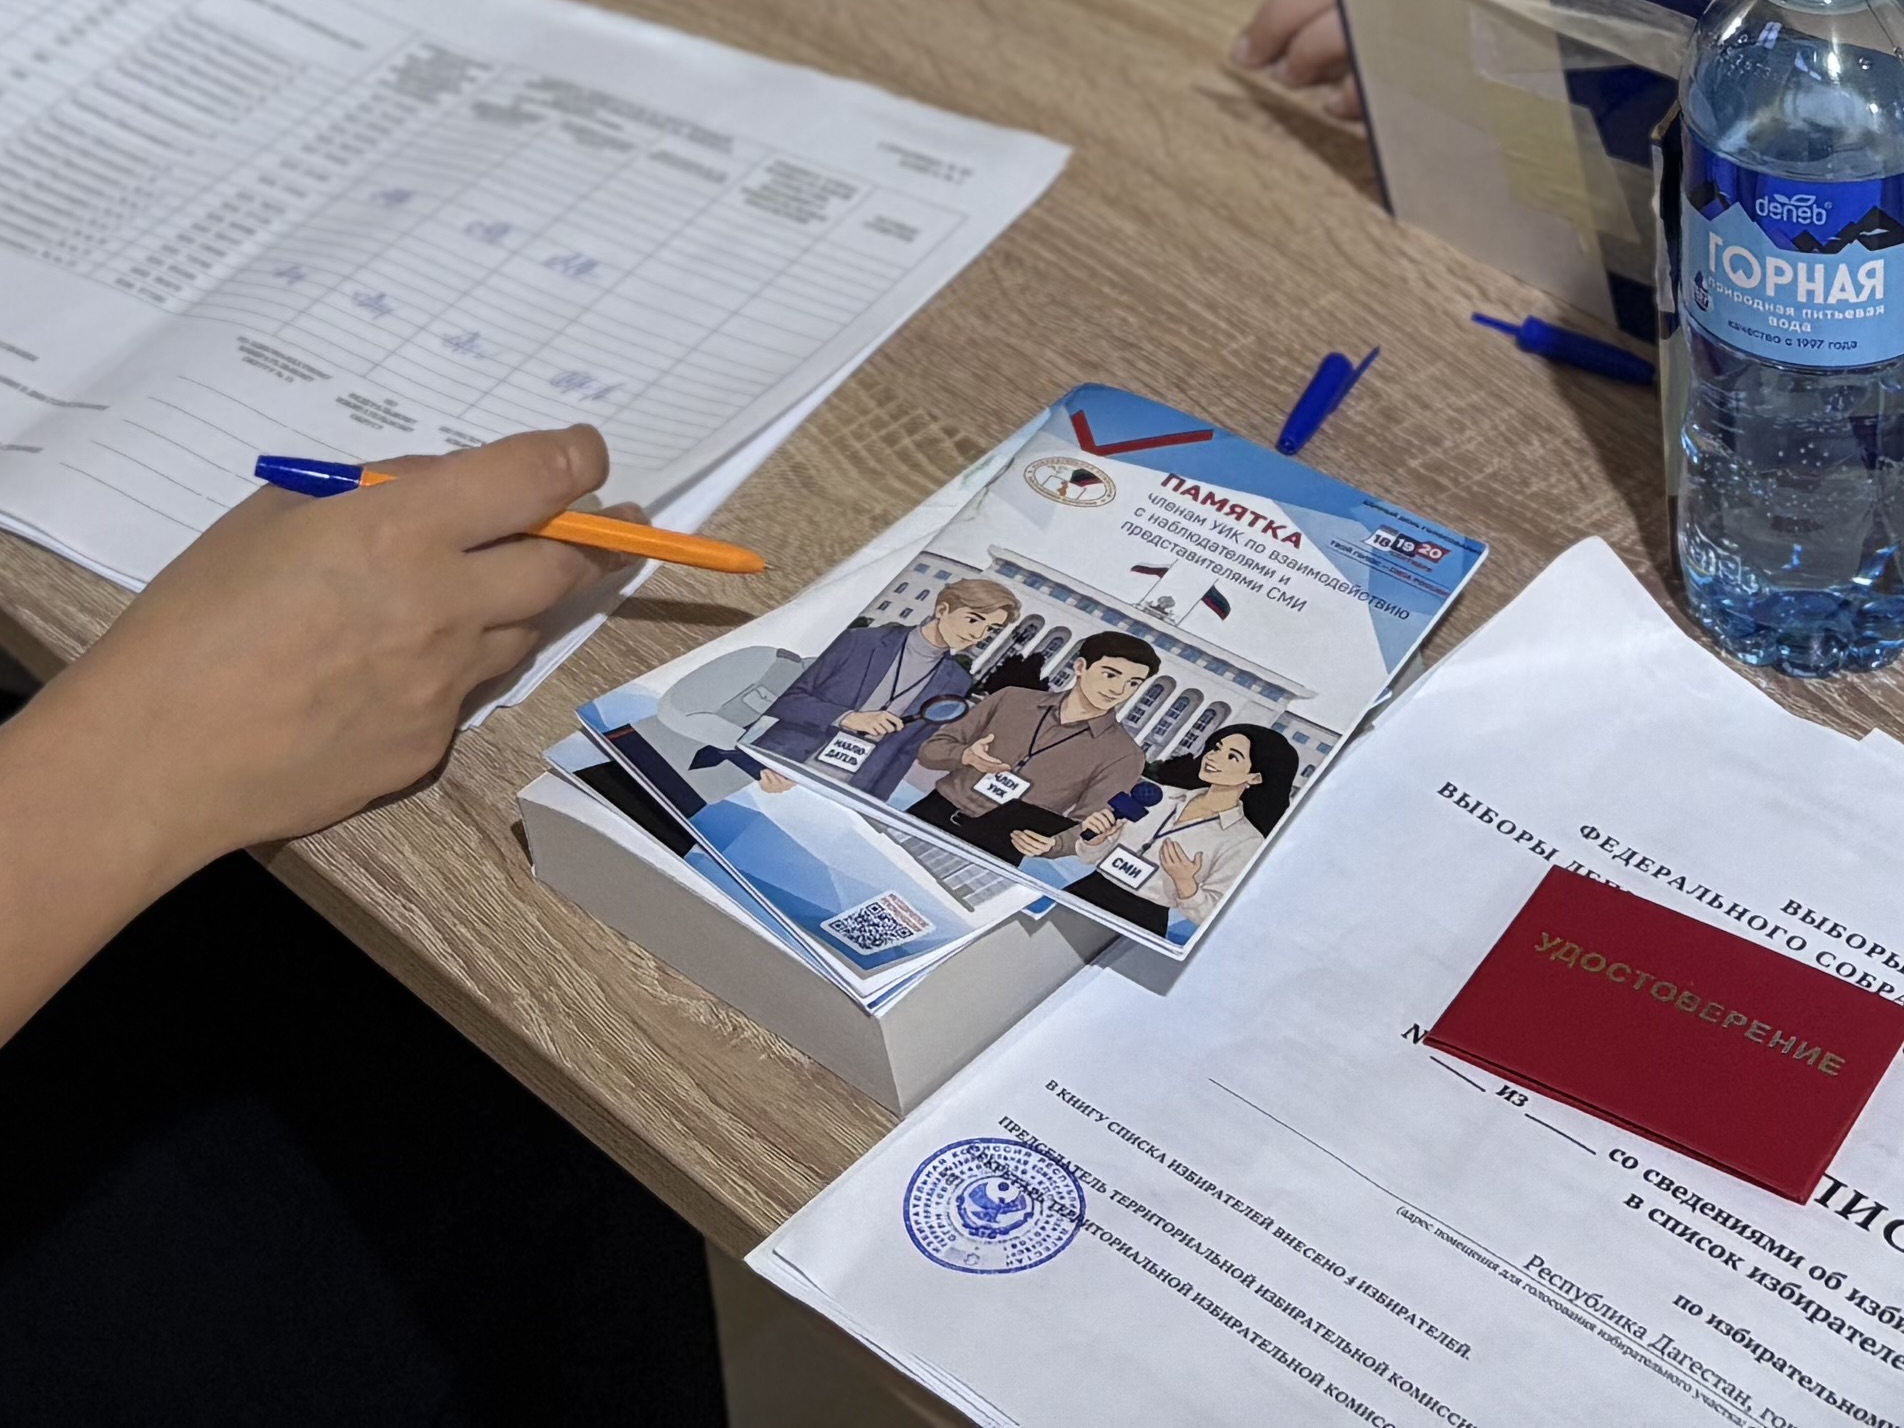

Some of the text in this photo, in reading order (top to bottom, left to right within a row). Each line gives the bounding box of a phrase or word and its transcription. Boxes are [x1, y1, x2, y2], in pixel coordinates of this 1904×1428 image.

[1755, 195, 1827, 225] deneb
[1707, 276, 1795, 317] природная
[1802, 304, 1885, 320] питьевая
[1708, 231, 1885, 305] ГОРНАЯ
[1768, 316, 1812, 333] вода
[1785, 337, 1793, 347] с
[1796, 338, 1825, 350] 1997
[1828, 340, 1858, 351] года
[1134, 506, 1292, 586] с наблюдателями и
[1161, 472, 1304, 548] ПАМЯТКА
[1373, 534, 1390, 547] 18
[1396, 538, 1416, 552] 19
[1418, 544, 1443, 559] 20
[1120, 519, 1309, 613] представителями СМИ
[1147, 493, 1411, 621] членам УИК по взаимодействию
[1437, 781, 1559, 862] ВЫБОРЫ
[1111, 856, 1143, 879] СМИ
[1579, 825, 1807, 951] ФЕДЕРАЛЬНОГО
[1533, 931, 1846, 1078] УДОСТОВЕРЕНИЕ
[909, 1156, 950, 1253] ИЗБИРАТЕЛЬНАЯ
[1005, 1227, 1069, 1266] ДАГЕСТАН
[1045, 1079, 1059, 1092] В
[1055, 1087, 1110, 1122] КНИГУ
[1107, 1121, 1167, 1164] СПИСКА
[1166, 1158, 1275, 1231] ИЗБИРАТЕЛЕЙ
[1271, 1226, 1347, 1278] ВНЕСЕНО
[1355, 1280, 1471, 1361] ИЗБИРАТЕЛЕЙ.
[1495, 1084, 1529, 1107] из
[1608, 1148, 1639, 1170] со
[1642, 1168, 1806, 1270] сведениями
[1808, 1265, 1848, 1290] об
[994, 1114, 1474, 1428] ПРЕДСЕДАТЕЛЬ ТЕРРИТОРИАЛЬНОЙ ИЗБИРАТЕЛЬНОЙ КОМИССИ
[1623, 1193, 1645, 1210] в
[1647, 1208, 1745, 1271] список
[1045, 1197, 1194, 1299] ТЕРРИТОРИАЛЬНОЙ
[1190, 1291, 1325, 1388] ИЗБИРАТЕЛЬНОЙ
[1672, 1294, 1704, 1316] по
[1522, 1254, 1648, 1341] Республика
[1646, 1333, 1752, 1413] Дагестан,
